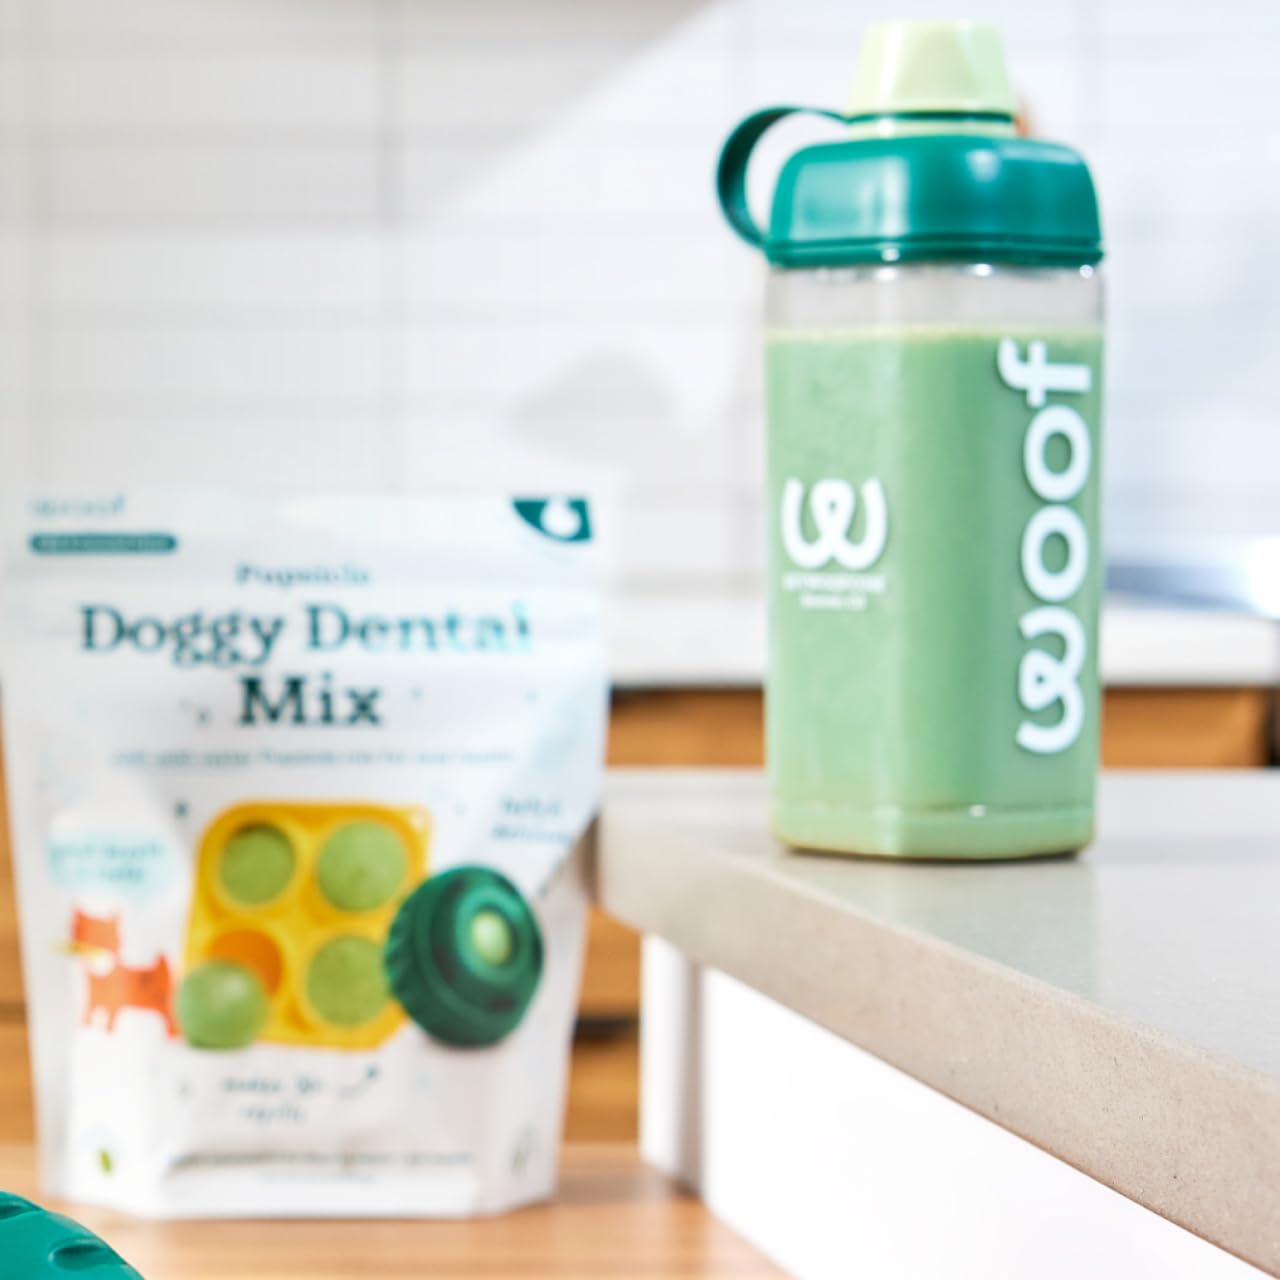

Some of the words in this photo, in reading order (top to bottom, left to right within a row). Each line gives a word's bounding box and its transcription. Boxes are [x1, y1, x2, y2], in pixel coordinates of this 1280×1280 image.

[996, 336, 1093, 755] woof
[79, 603, 286, 669] Doggy
[304, 602, 534, 655] Dental
[237, 671, 384, 728] Mix
